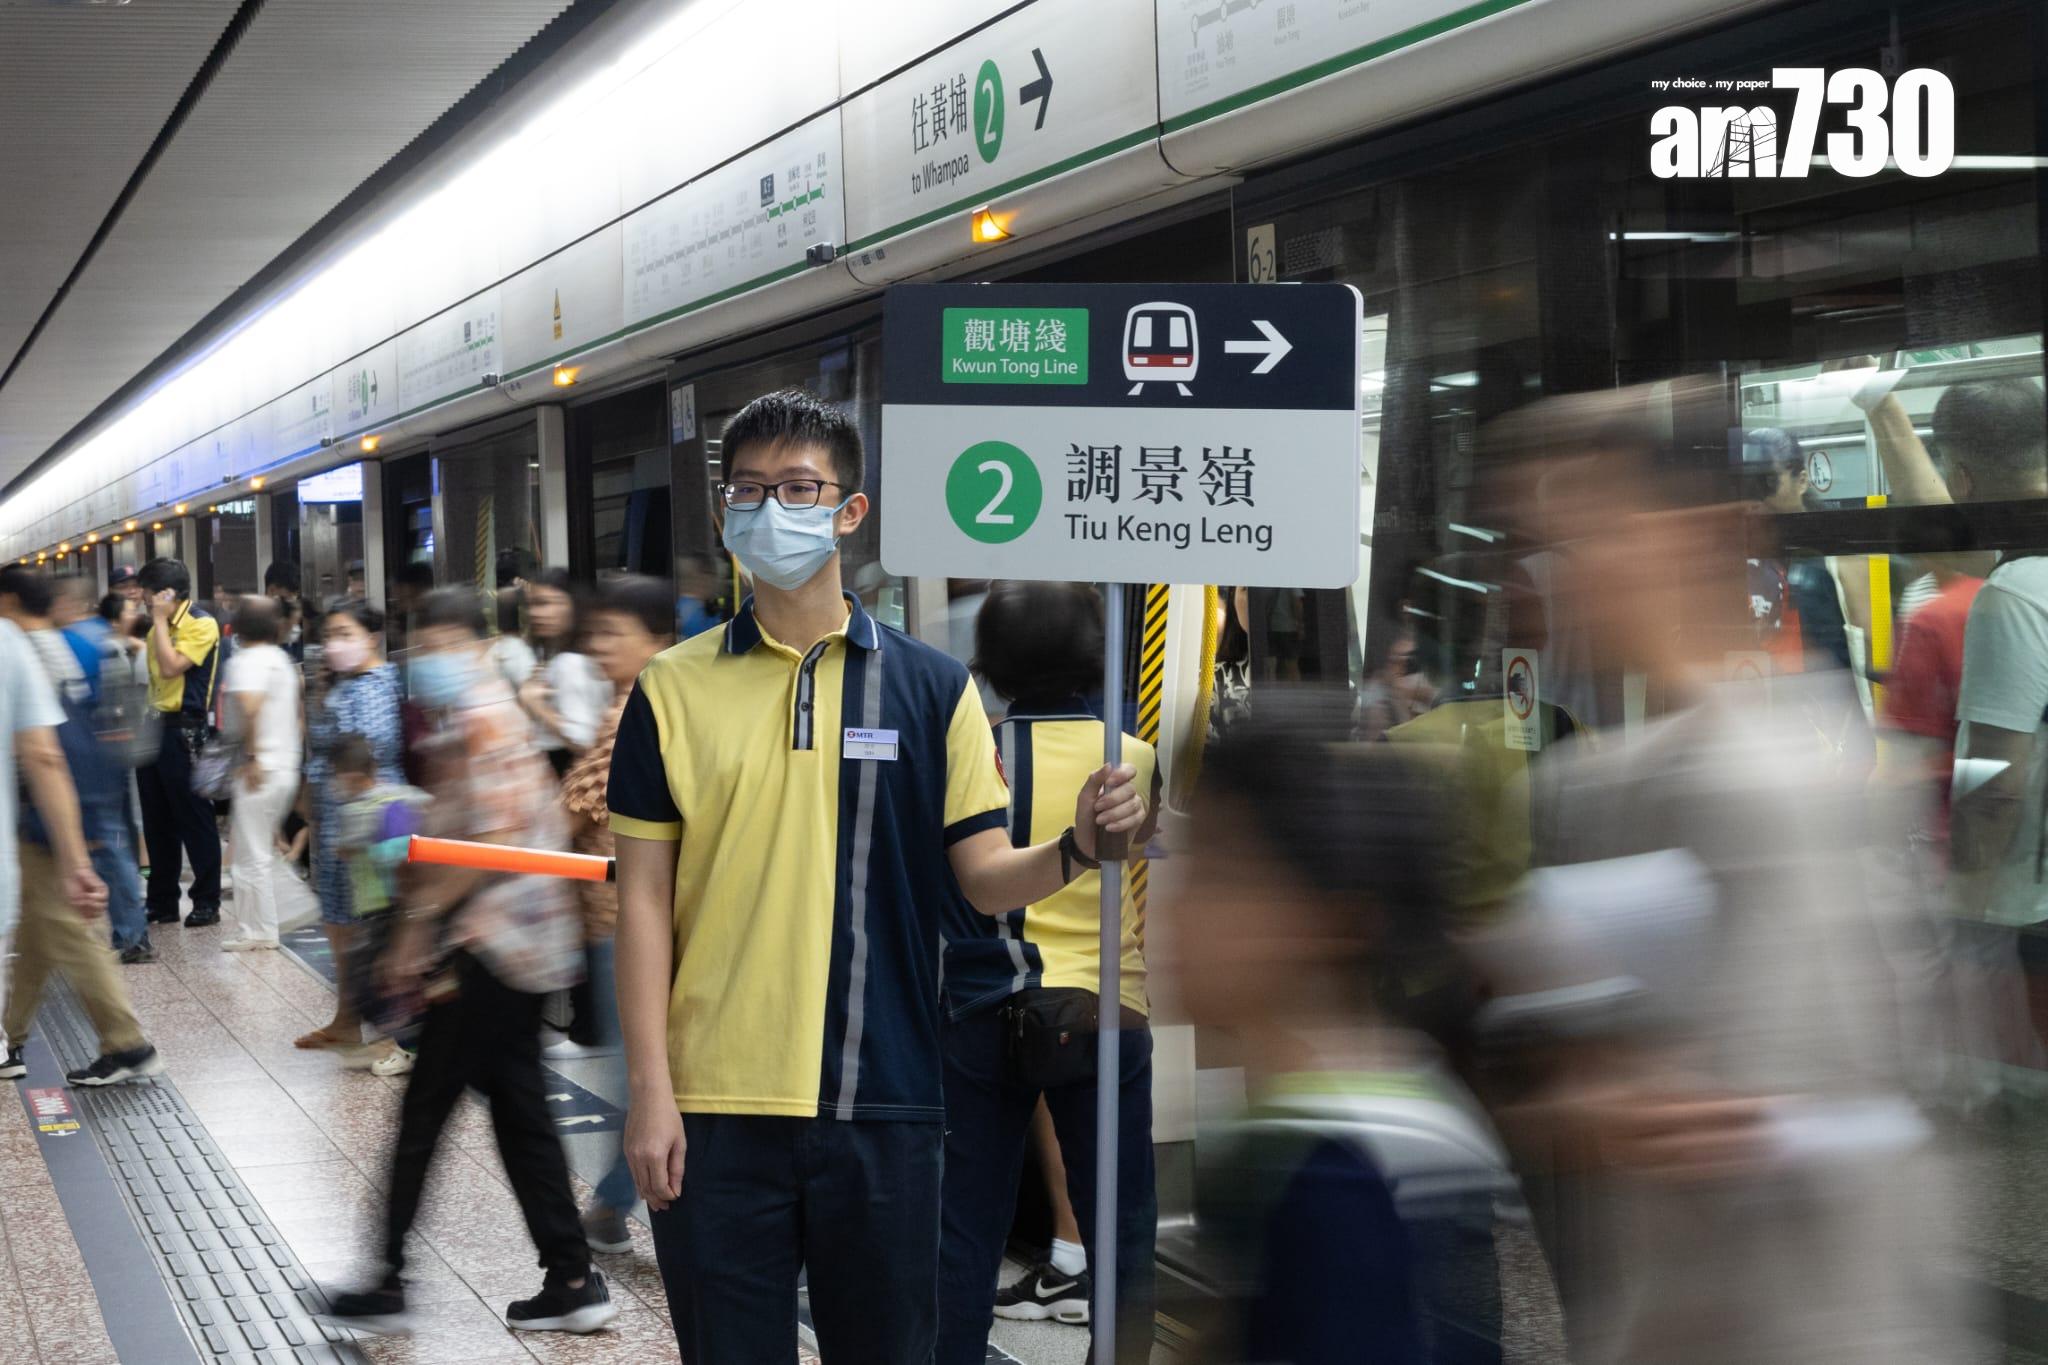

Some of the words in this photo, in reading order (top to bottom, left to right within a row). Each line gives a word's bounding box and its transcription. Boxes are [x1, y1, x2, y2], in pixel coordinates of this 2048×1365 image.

[911, 73, 968, 155] 往黃埔
[982, 79, 997, 145] 2
[912, 171, 921, 195] to
[922, 153, 969, 190] Whampoa
[1250, 236, 1275, 284] 6-2
[963, 318, 1067, 353] 觀塘綫
[952, 358, 997, 374] Kwun
[1000, 358, 1040, 378] Tong
[1044, 359, 1078, 375] Line
[975, 460, 1015, 525] 2
[1065, 443, 1256, 507] 調景嶺
[1064, 514, 1107, 541] Tiu
[1117, 515, 1191, 550] Keng
[1201, 516, 1273, 551] Leng
